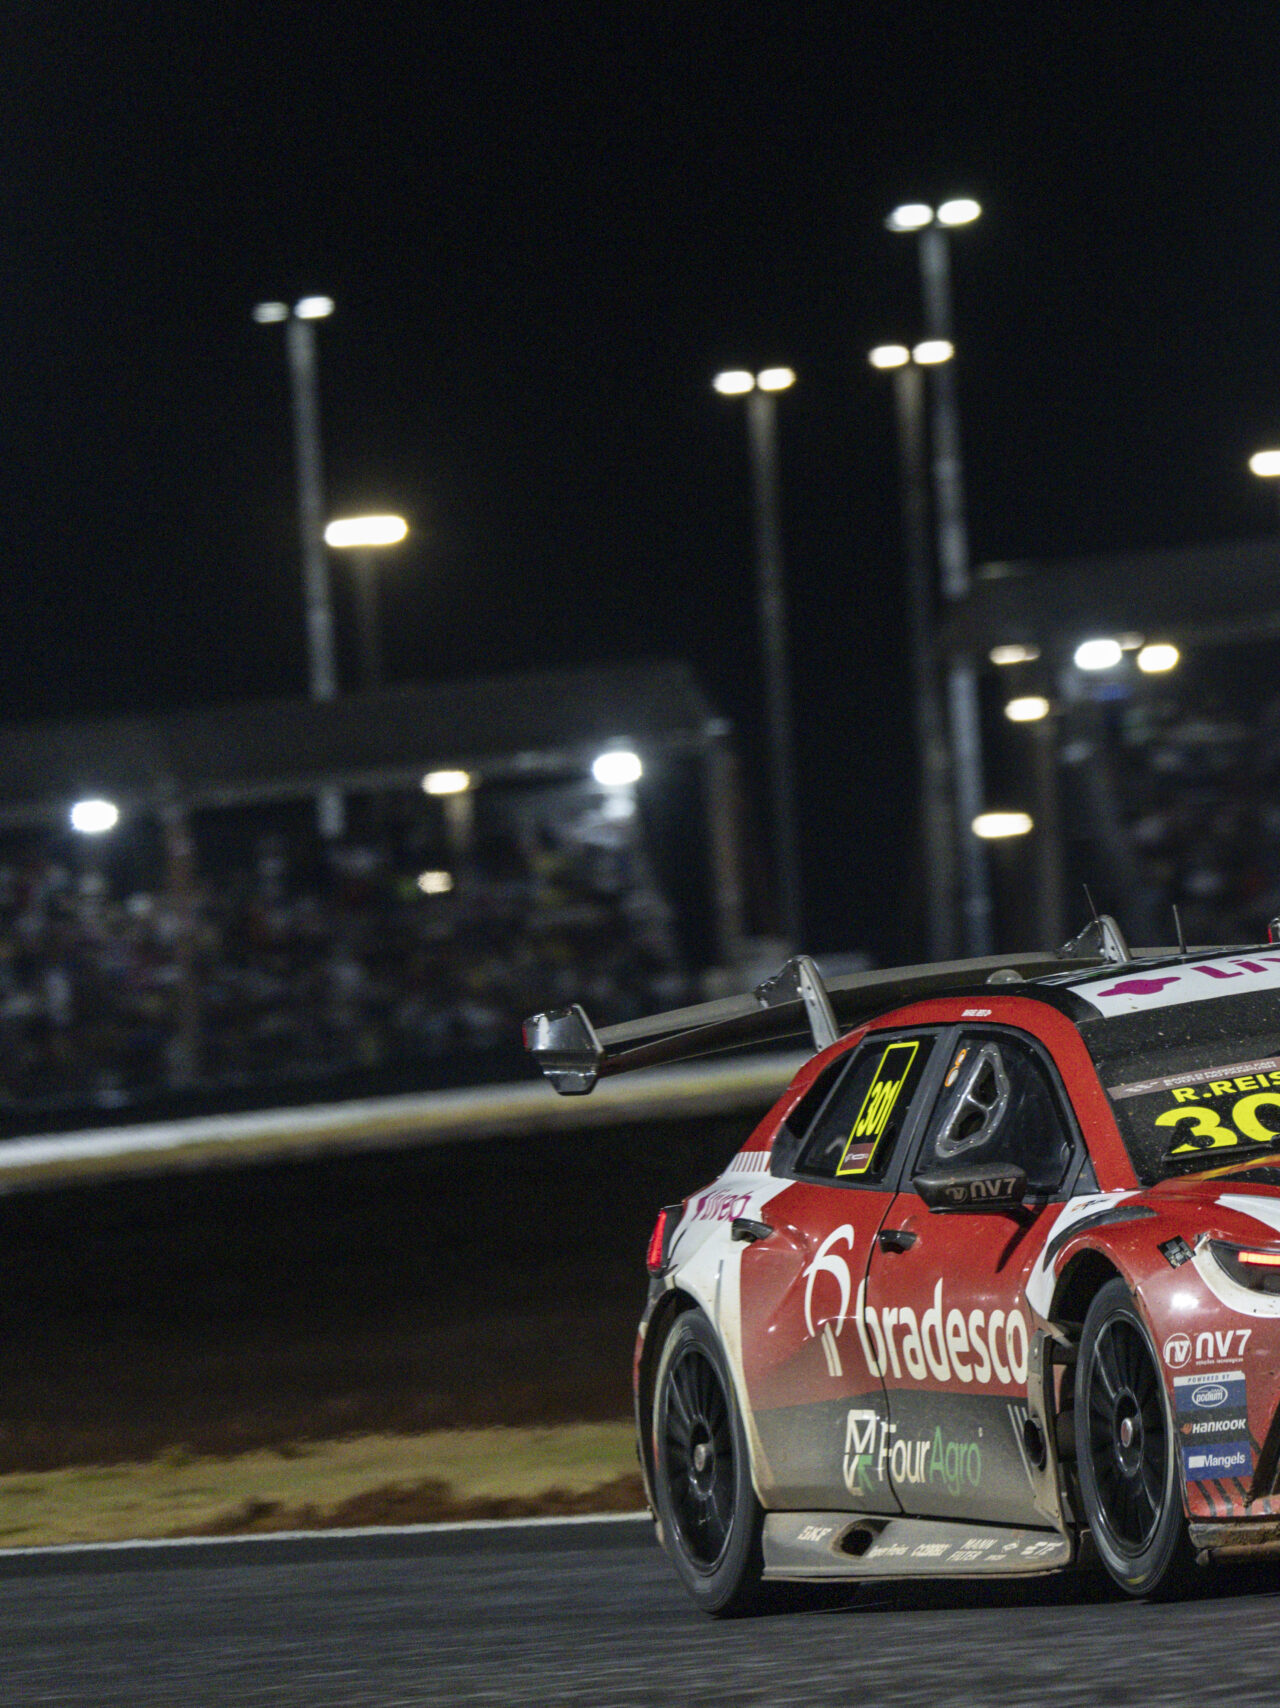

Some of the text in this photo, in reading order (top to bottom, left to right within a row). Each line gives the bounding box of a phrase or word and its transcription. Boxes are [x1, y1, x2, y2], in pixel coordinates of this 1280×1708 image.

[855, 1080, 901, 1138] 301
[855, 1276, 1030, 1385] bradesco
[877, 1421, 982, 1497] FourAgro
[1203, 1451, 1246, 1468] Mangels
[796, 1525, 833, 1541] SKF
[959, 1538, 999, 1550] MANN
[946, 1550, 983, 1562] FILTER
